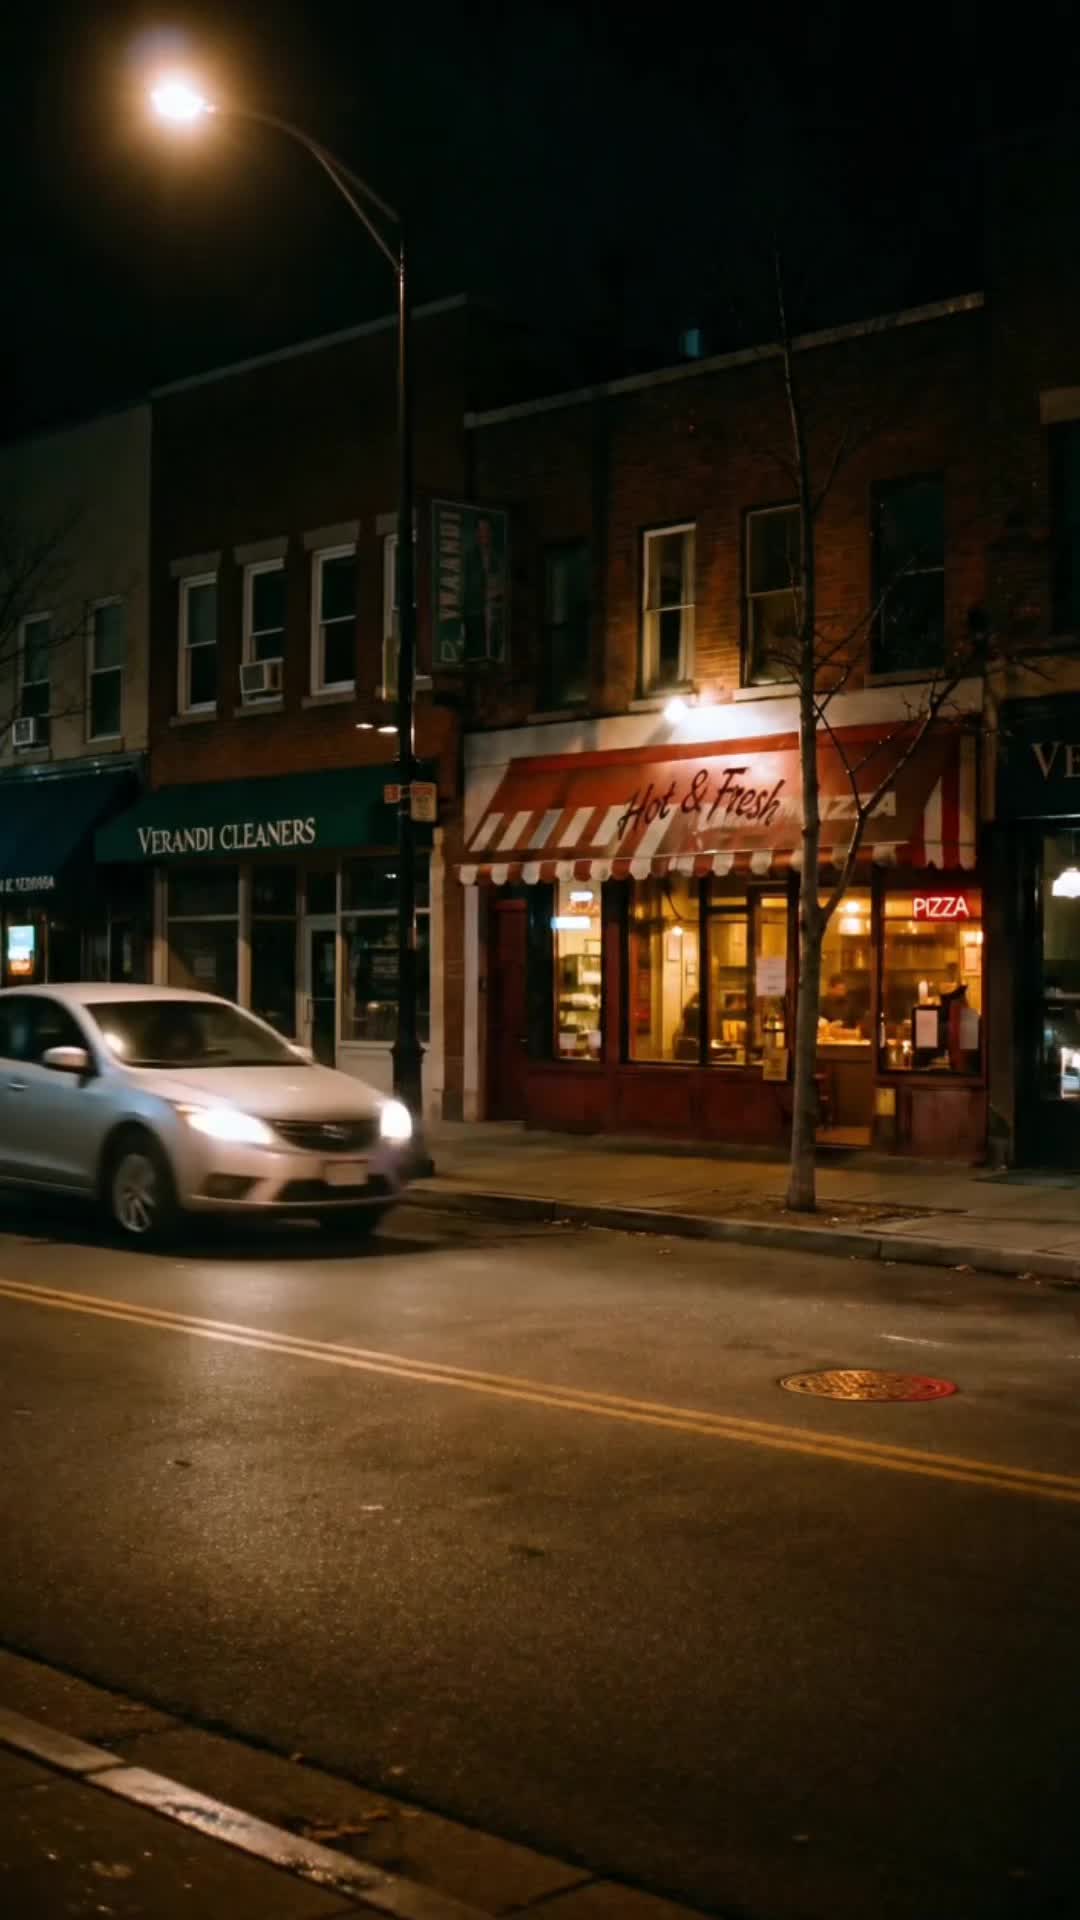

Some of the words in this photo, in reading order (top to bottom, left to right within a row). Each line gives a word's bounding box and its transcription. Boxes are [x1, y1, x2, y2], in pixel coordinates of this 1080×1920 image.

[617, 780, 677, 841] Hot
[681, 768, 709, 814] &
[706, 766, 786, 827] Fresh
[137, 826, 214, 855] VERANDI
[219, 816, 316, 850] CLEANERS
[913, 895, 970, 918] PIZZA
